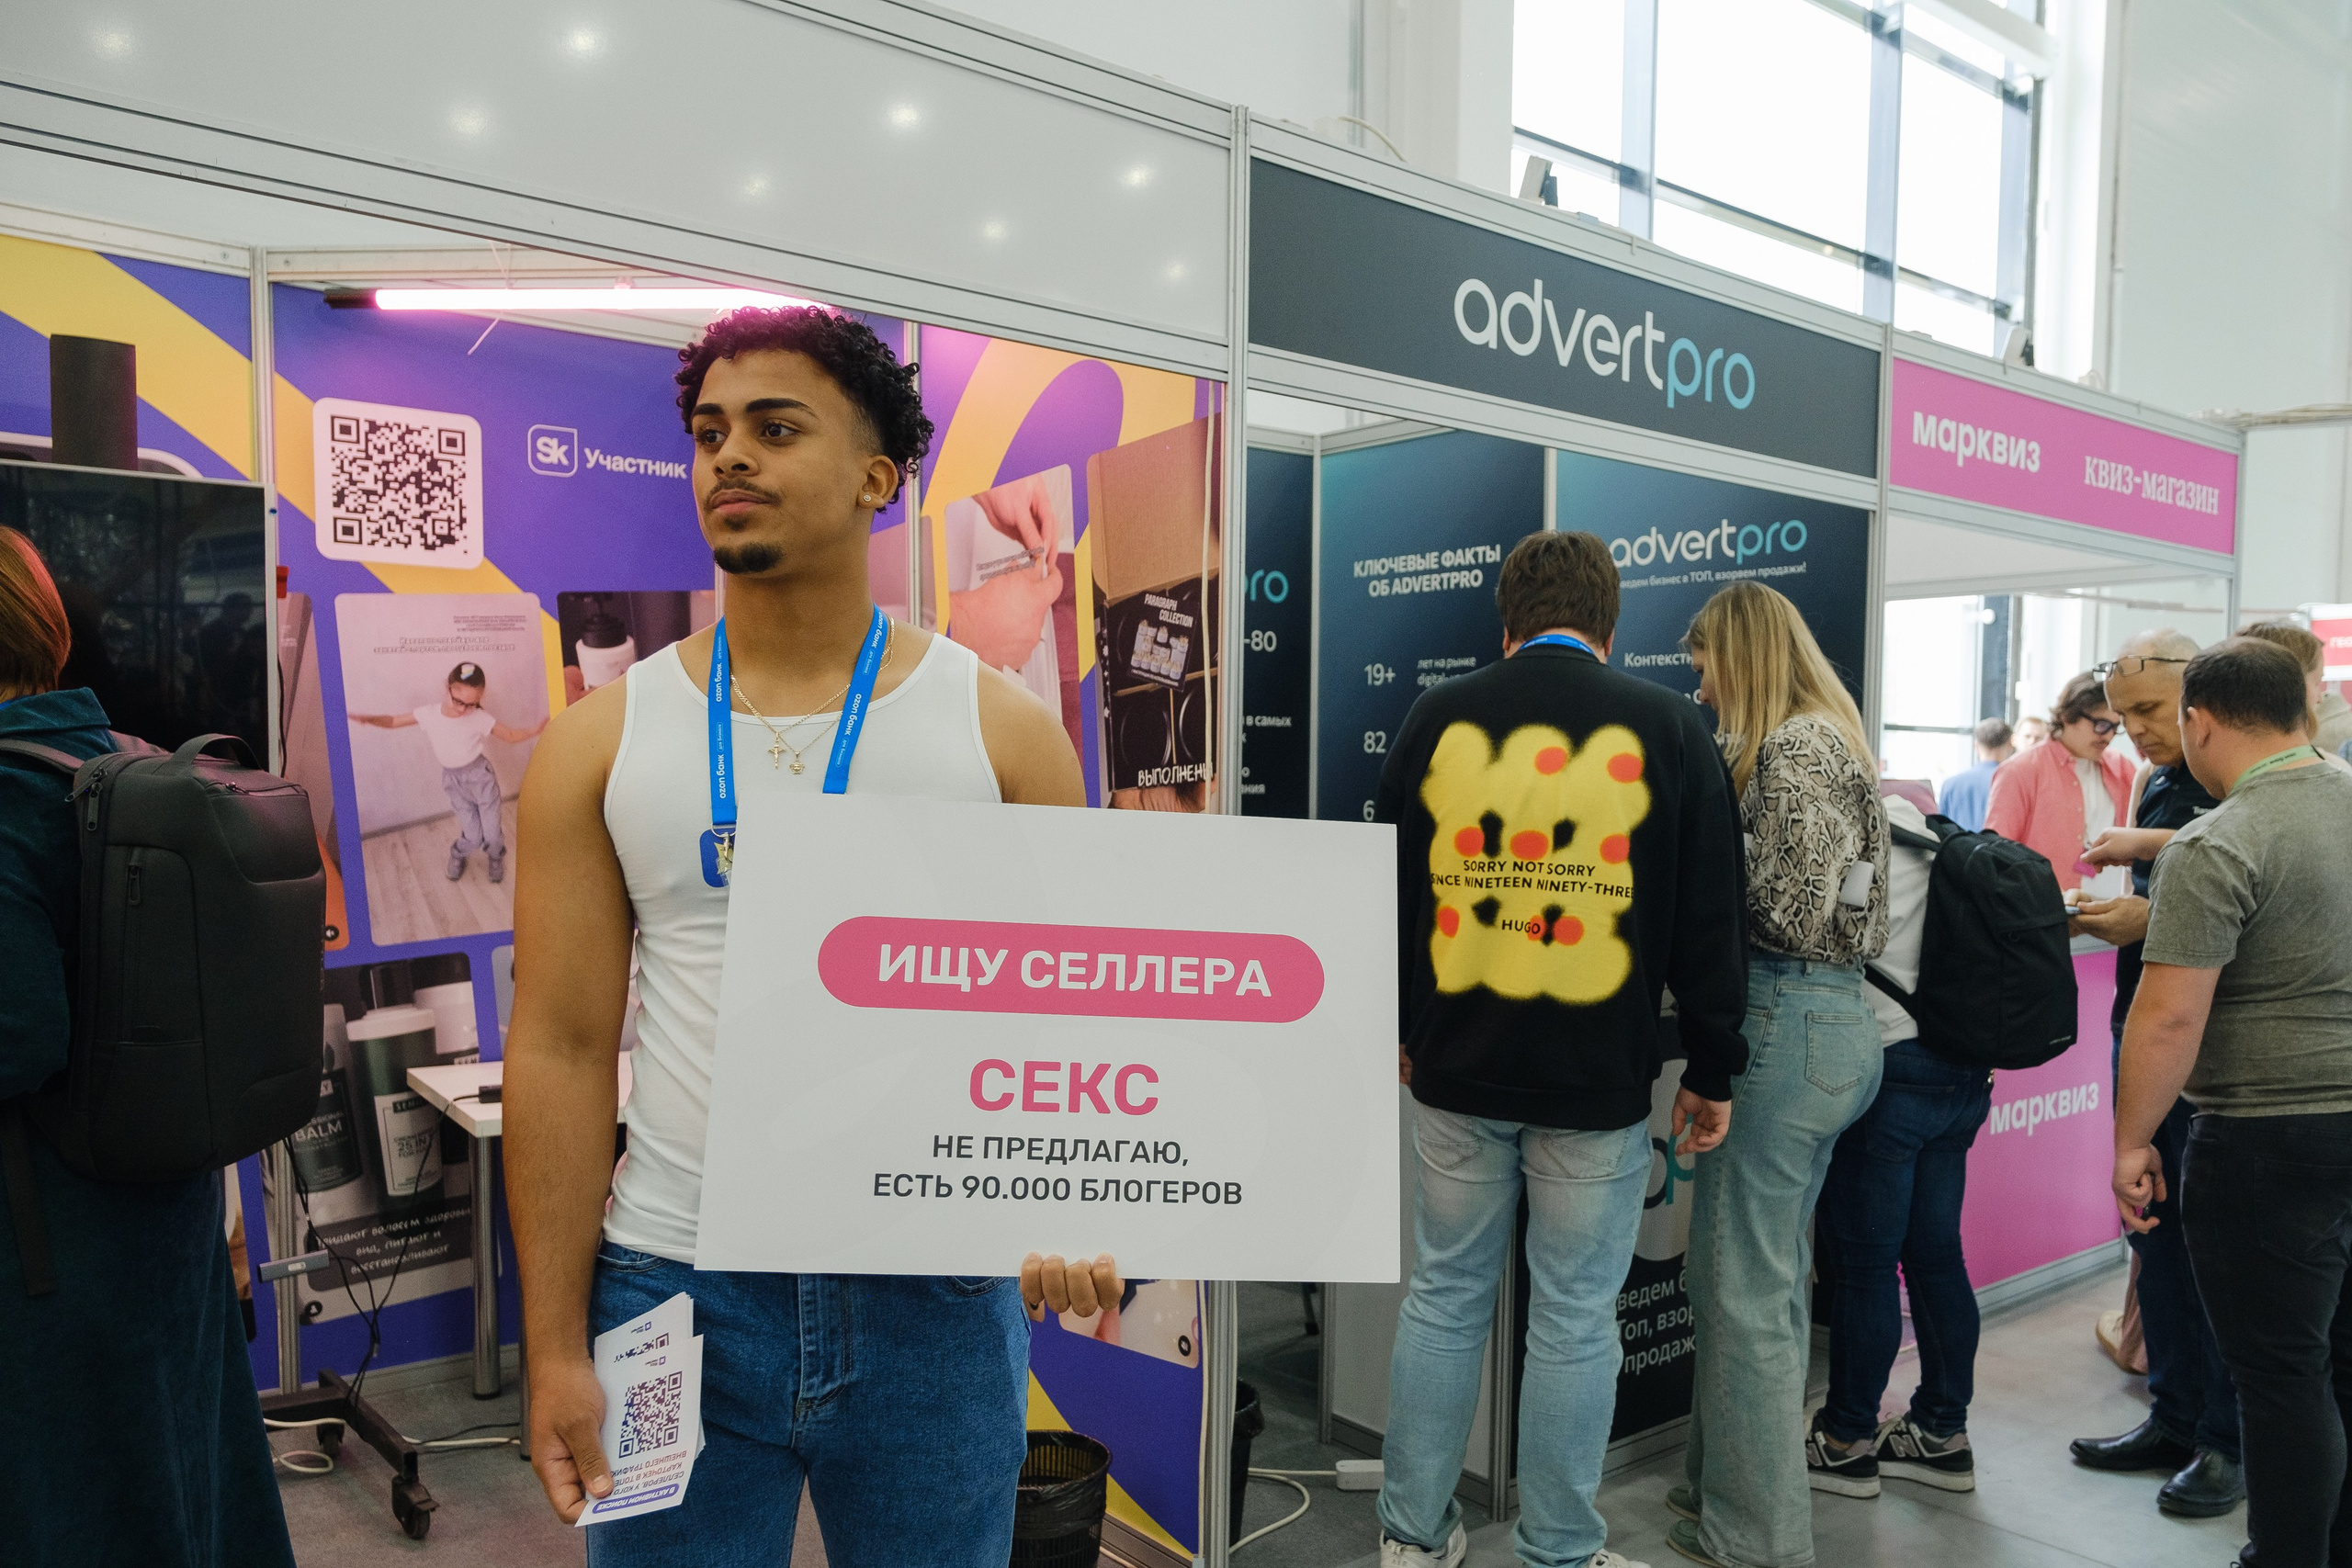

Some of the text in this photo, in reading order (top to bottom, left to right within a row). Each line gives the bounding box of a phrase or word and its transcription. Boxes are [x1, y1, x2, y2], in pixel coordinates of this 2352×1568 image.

[1453, 278, 1756, 410] advertpro
[536, 436, 570, 466] Sk
[583, 447, 687, 479] Участник
[1912, 411, 2219, 515] марквиз квиз-магазин
[1609, 519, 1807, 568] advertpro
[1353, 544, 1501, 578] КЛЮЧЕВЫЕ ФАКТЫ
[1245, 570, 1289, 604] ro
[1368, 569, 1483, 597] ОБ ADVERTPRO
[1690, 570, 1714, 583] ТОП,
[1144, 593, 1178, 611] PARAGRAPH
[1159, 609, 1193, 628] COLLECTION
[1363, 663, 1396, 686] 19+
[1418, 657, 1476, 670] лет на рынке
[844, 693, 862, 736] ozon банк
[717, 754, 727, 798] ozon банк
[1464, 860, 1596, 876] SORRY NOT SORRY
[1464, 875, 1532, 889] NINETEEN
[1536, 878, 1634, 899] NINETY-THREE
[1501, 919, 1541, 935] HUGO
[878, 943, 1272, 998] ИЩУ СЕЛЛЕРА
[969, 1058, 1159, 1116] СЕКС
[1990, 1081, 2099, 1137] марквиз
[295, 1119, 342, 1142] BALM
[933, 1134, 1189, 1167] НЕ ПРЕДЛАГАЮ,
[874, 1173, 1243, 1205] ЕСТЬ 90.000 БЛОГЕРОВ
[643, 1461, 683, 1479] КАРТОЧЕК
[645, 1450, 687, 1467] ВНЕШНЕГО
[614, 1486, 634, 1495] КОГО
[642, 1471, 684, 1488] СЕЛЛЕРОВ,
[596, 1497, 628, 1511] ПОИСКЕ
[628, 1488, 669, 1502] АКТИВНОМ
